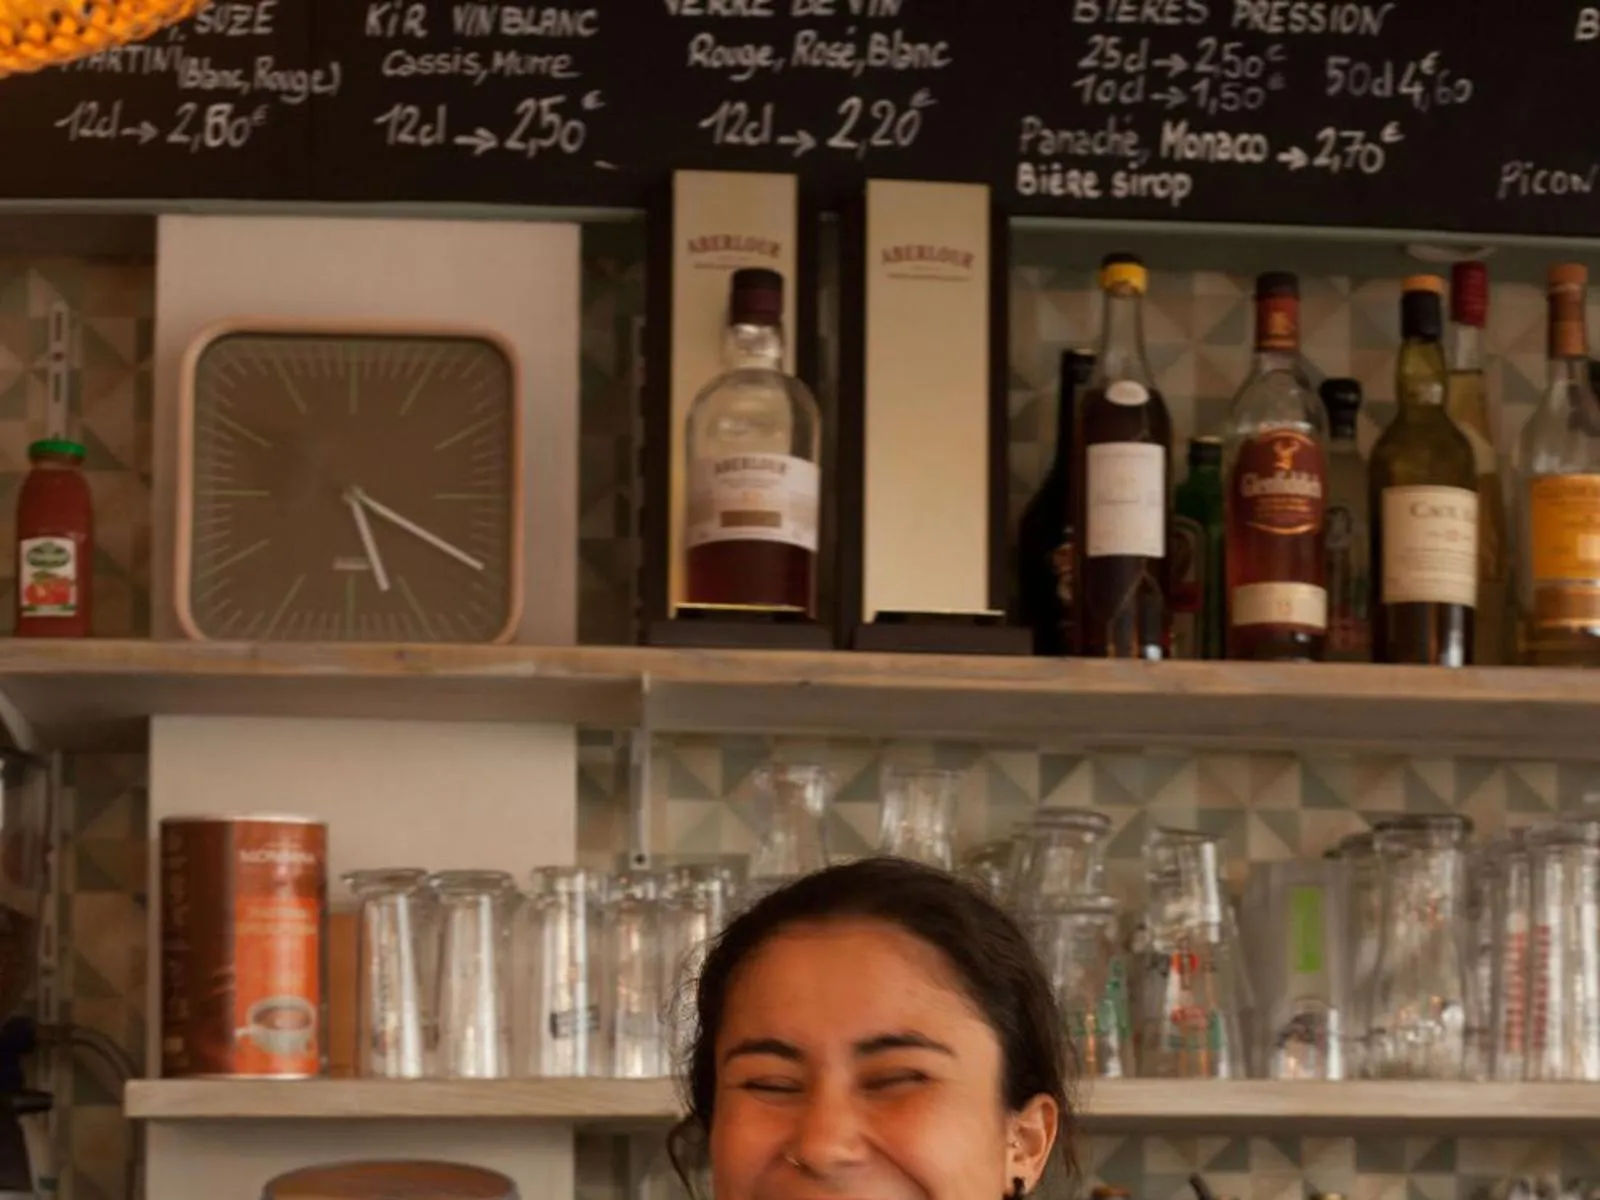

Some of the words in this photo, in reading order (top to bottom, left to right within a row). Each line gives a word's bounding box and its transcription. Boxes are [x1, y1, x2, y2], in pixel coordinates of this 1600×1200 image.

[453, 3, 498, 37] VIN
[501, 5, 598, 37] BLANC
[1232, 1, 1396, 36] PRESSION
[868, 29, 953, 71] Blanc
[1160, 119, 1268, 163] Monaco
[1111, 160, 1192, 207] sirop
